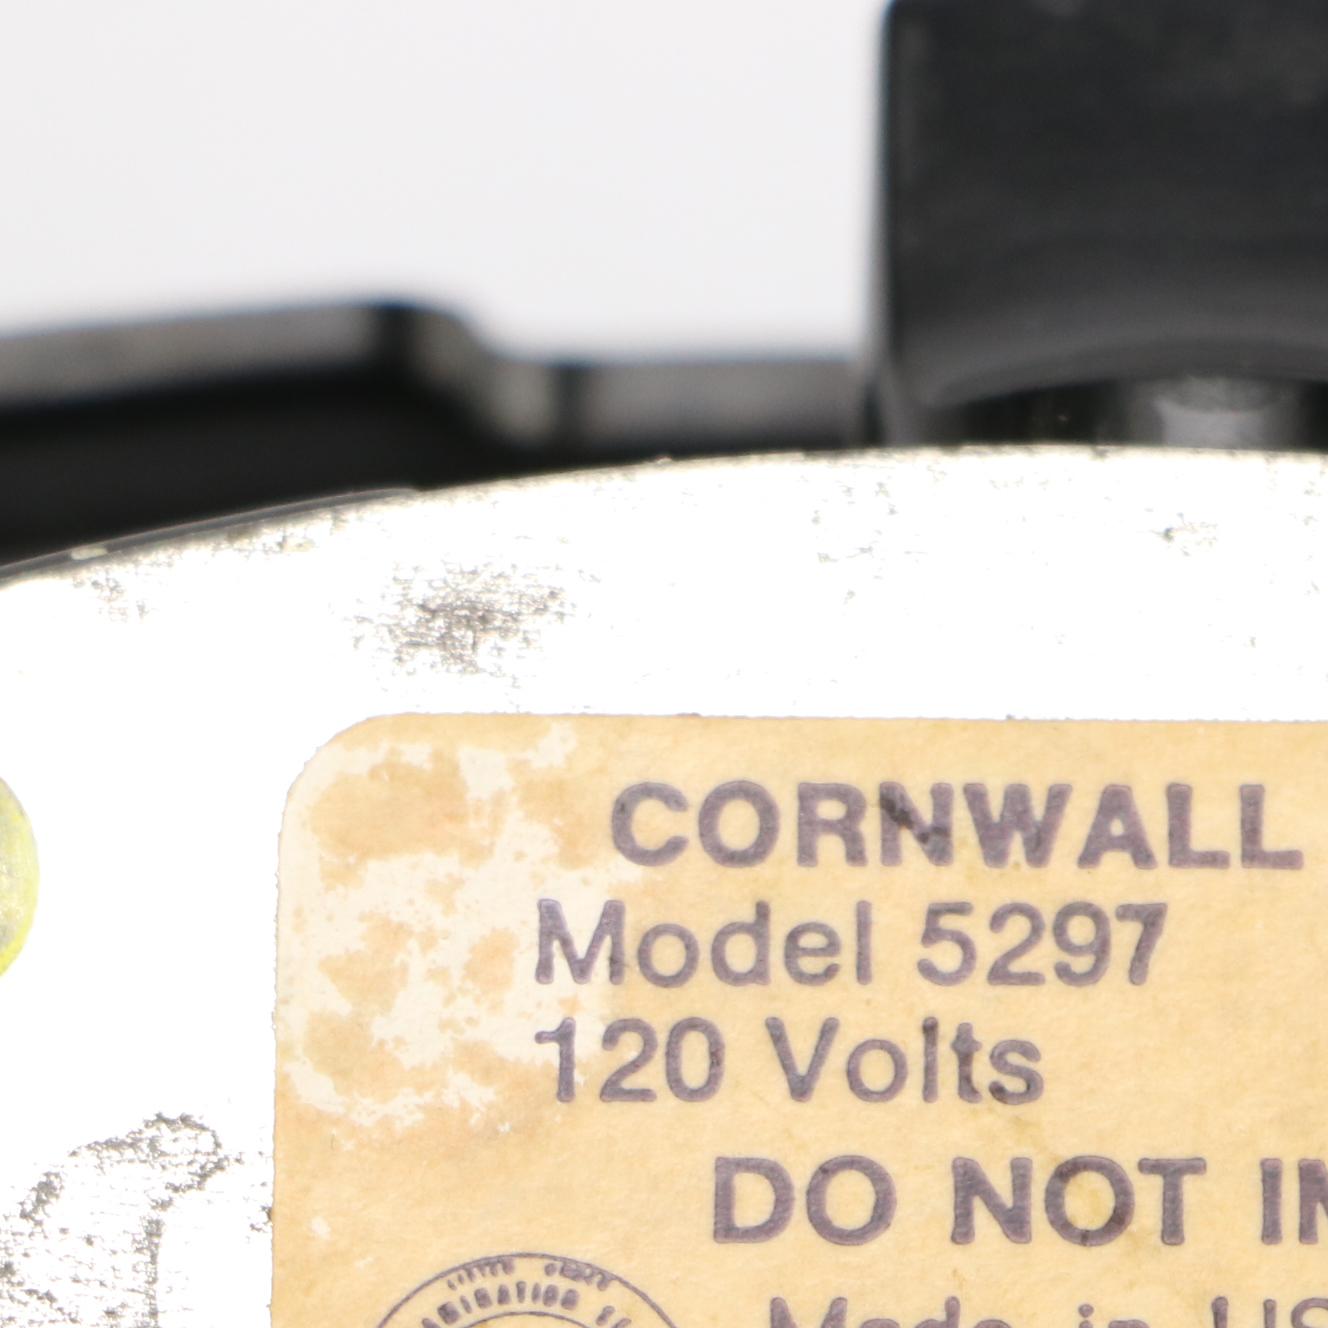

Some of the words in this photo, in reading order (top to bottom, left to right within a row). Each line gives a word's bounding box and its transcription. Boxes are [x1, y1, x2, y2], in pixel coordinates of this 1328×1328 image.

[612, 781, 1303, 867] CORNWALL
[536, 900, 869, 987] Model
[918, 902, 1164, 984] 5297
[536, 1018, 723, 1101] 120
[766, 1018, 1041, 1104] Volts
[714, 1156, 893, 1245] DO
[951, 1156, 1206, 1246] NOT
